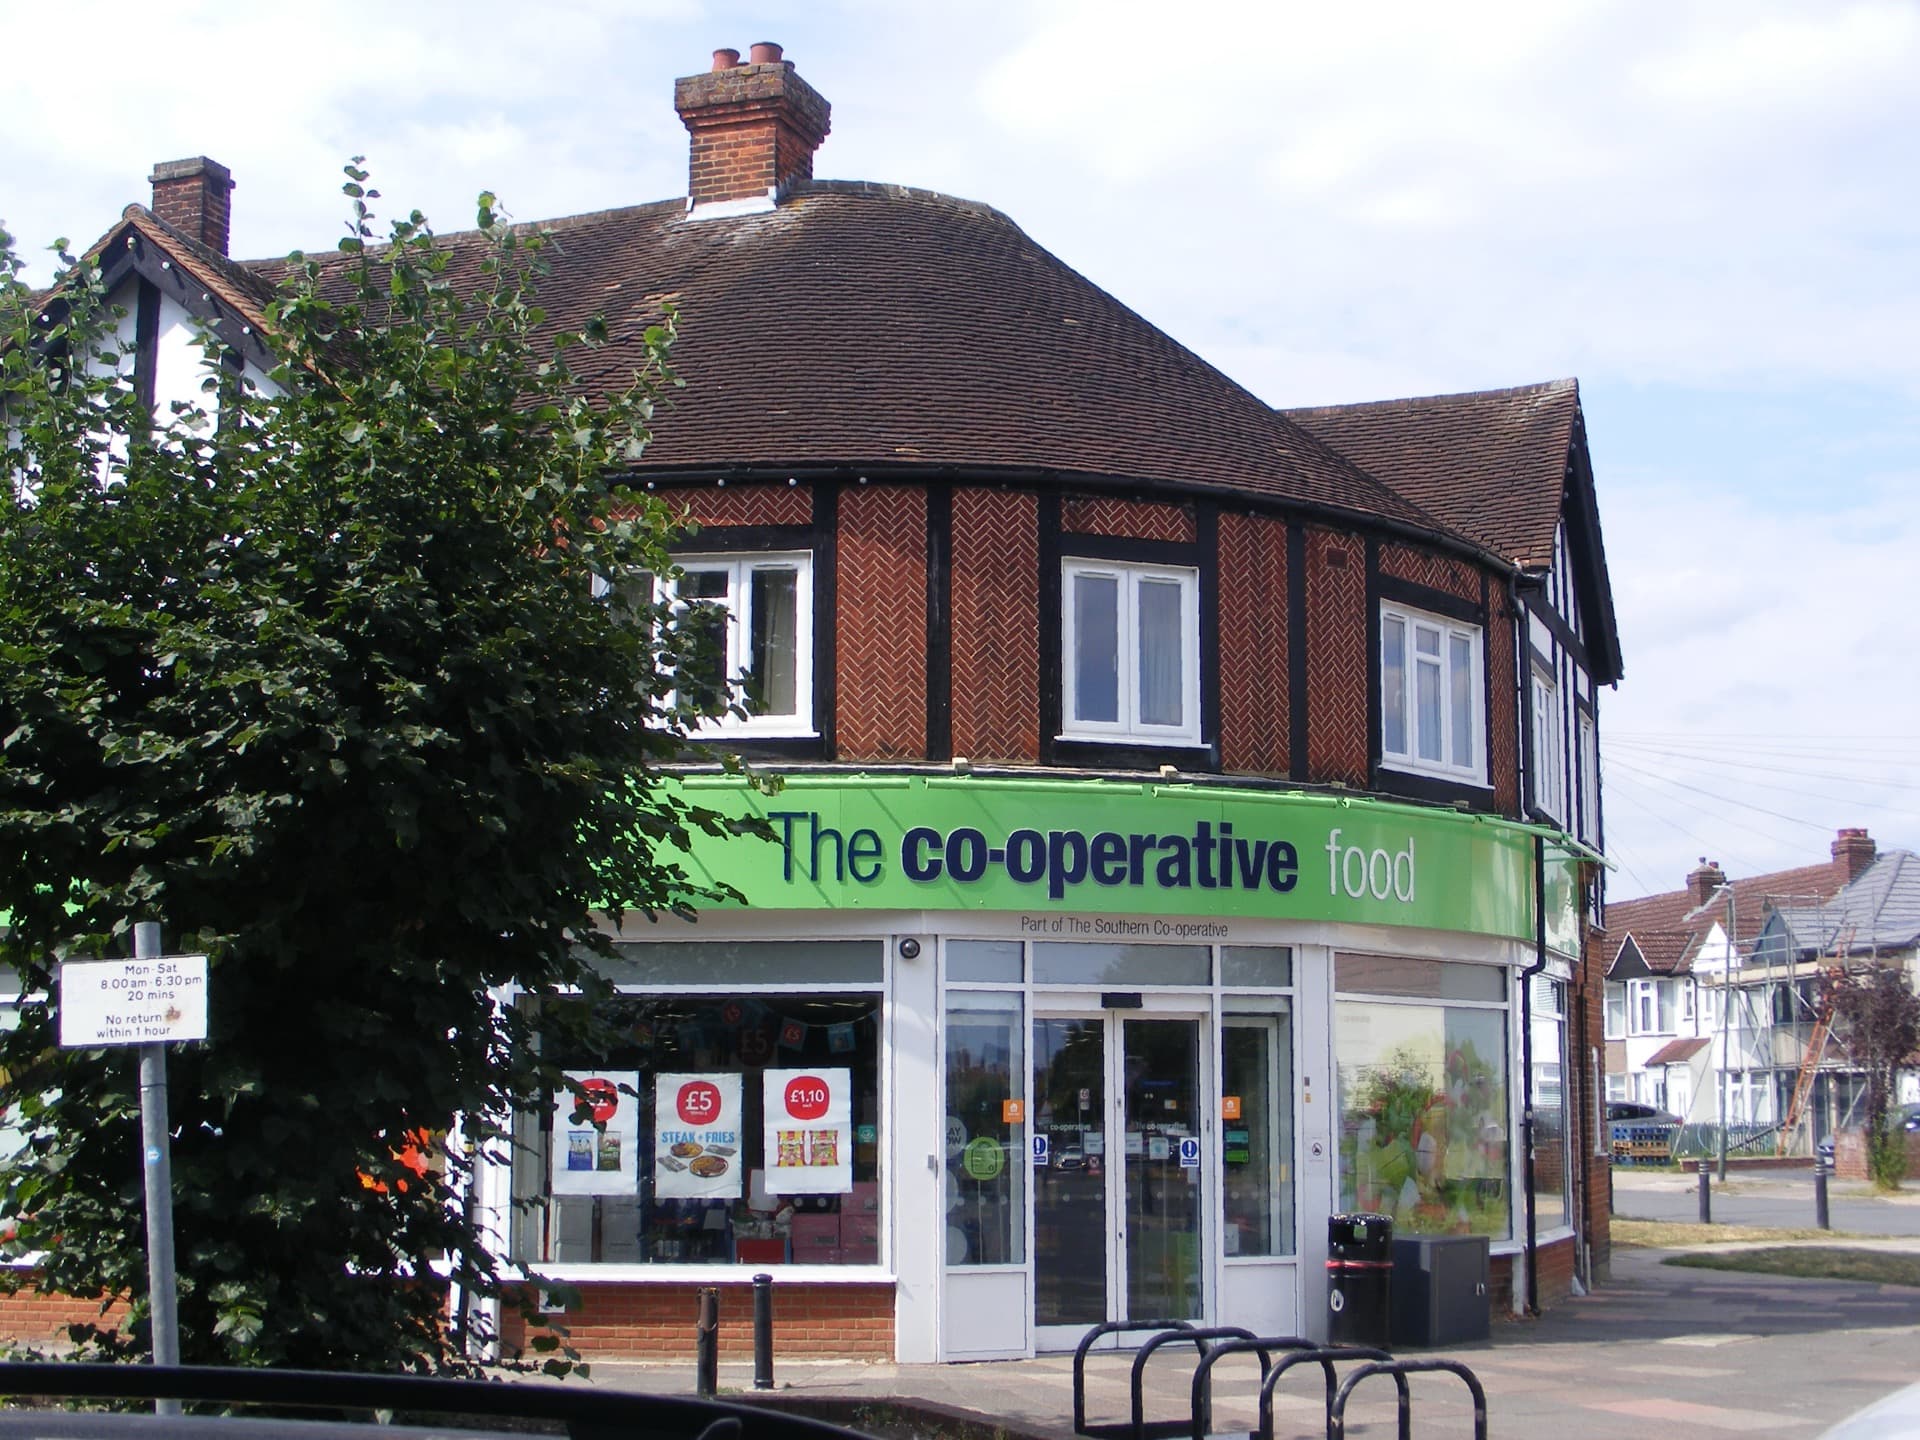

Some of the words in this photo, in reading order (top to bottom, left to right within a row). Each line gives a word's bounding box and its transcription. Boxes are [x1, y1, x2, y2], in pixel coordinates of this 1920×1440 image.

[768, 811, 882, 883] The
[901, 820, 1299, 900] co-operative
[1325, 828, 1416, 903] food
[1021, 916, 1047, 932] Part
[1051, 917, 1063, 932] of
[1068, 917, 1091, 933] The
[1094, 918, 1149, 935] Southern
[1153, 920, 1229, 939] Co-operative
[124, 965, 150, 975] Mon
[157, 963, 177, 974] Sat
[127, 990, 144, 1001] 20
[147, 990, 175, 1000] mins
[106, 1015, 122, 1025] No
[126, 1013, 162, 1024] return
[97, 1026, 132, 1039] within
[136, 1026, 140, 1036] 1
[144, 1026, 171, 1036] hour
[685, 1090, 713, 1112] £5
[790, 1089, 825, 1103] £1.10
[662, 1131, 696, 1144] STEAK
[705, 1131, 735, 1143] FRIES
